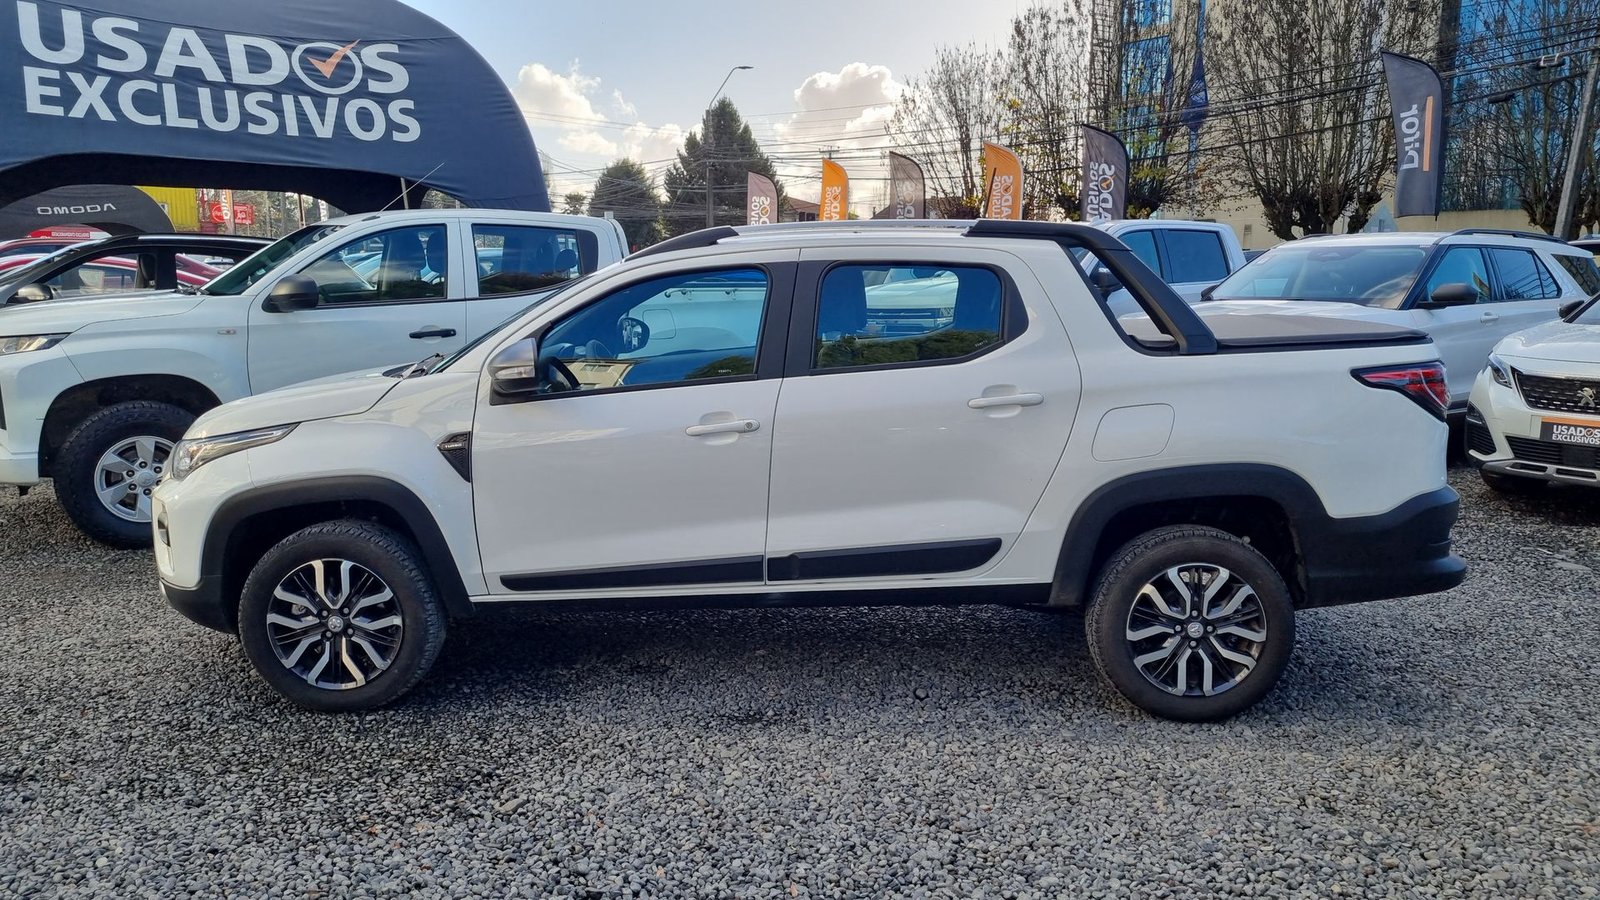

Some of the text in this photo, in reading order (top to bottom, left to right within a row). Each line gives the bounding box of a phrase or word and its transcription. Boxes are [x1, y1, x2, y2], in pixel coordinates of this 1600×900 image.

[16, 1, 409, 95] USADOS
[23, 66, 421, 142] EXCLUSIVOS
[1552, 433, 1600, 445] EXCLUSIVOS
[1553, 424, 1600, 438] USADOS
